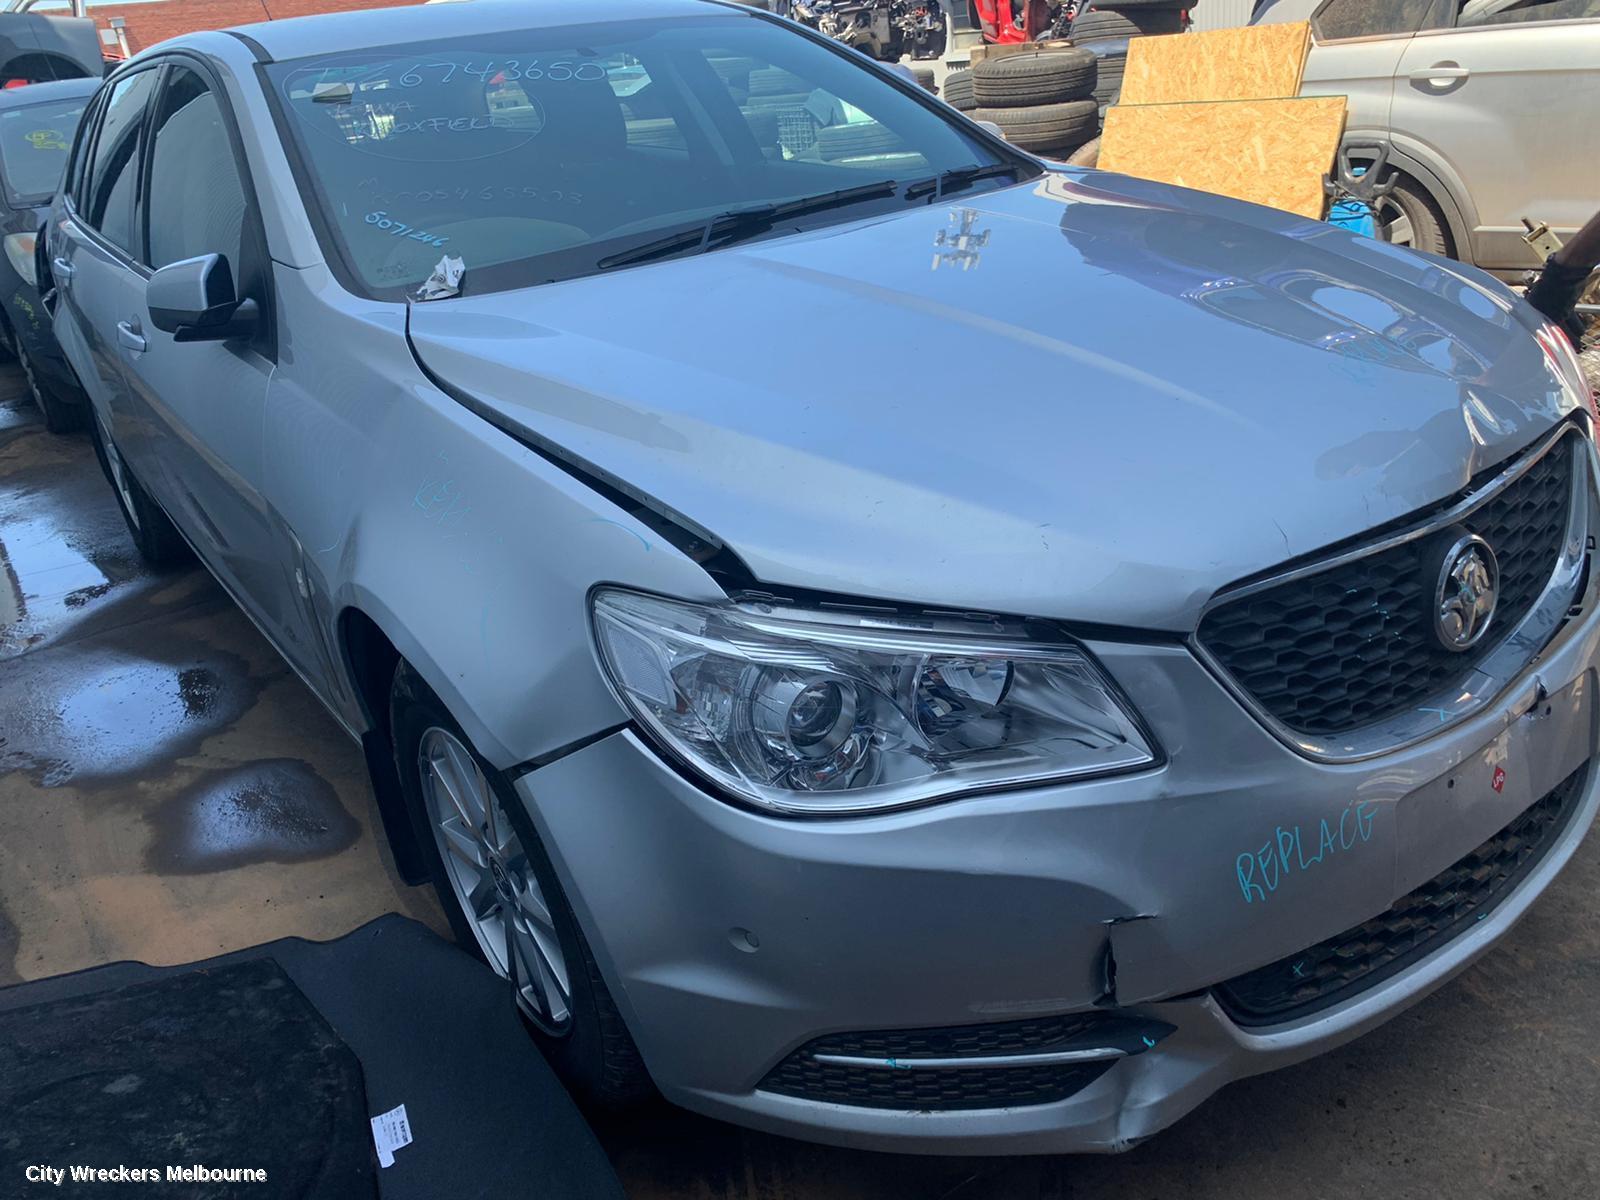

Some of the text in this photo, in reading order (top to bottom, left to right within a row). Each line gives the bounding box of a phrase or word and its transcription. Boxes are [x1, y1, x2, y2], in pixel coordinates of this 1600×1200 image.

[400, 60, 606, 88] 6743650
[364, 211, 449, 247] 5071246
[1236, 799, 1378, 904] REPLACE
